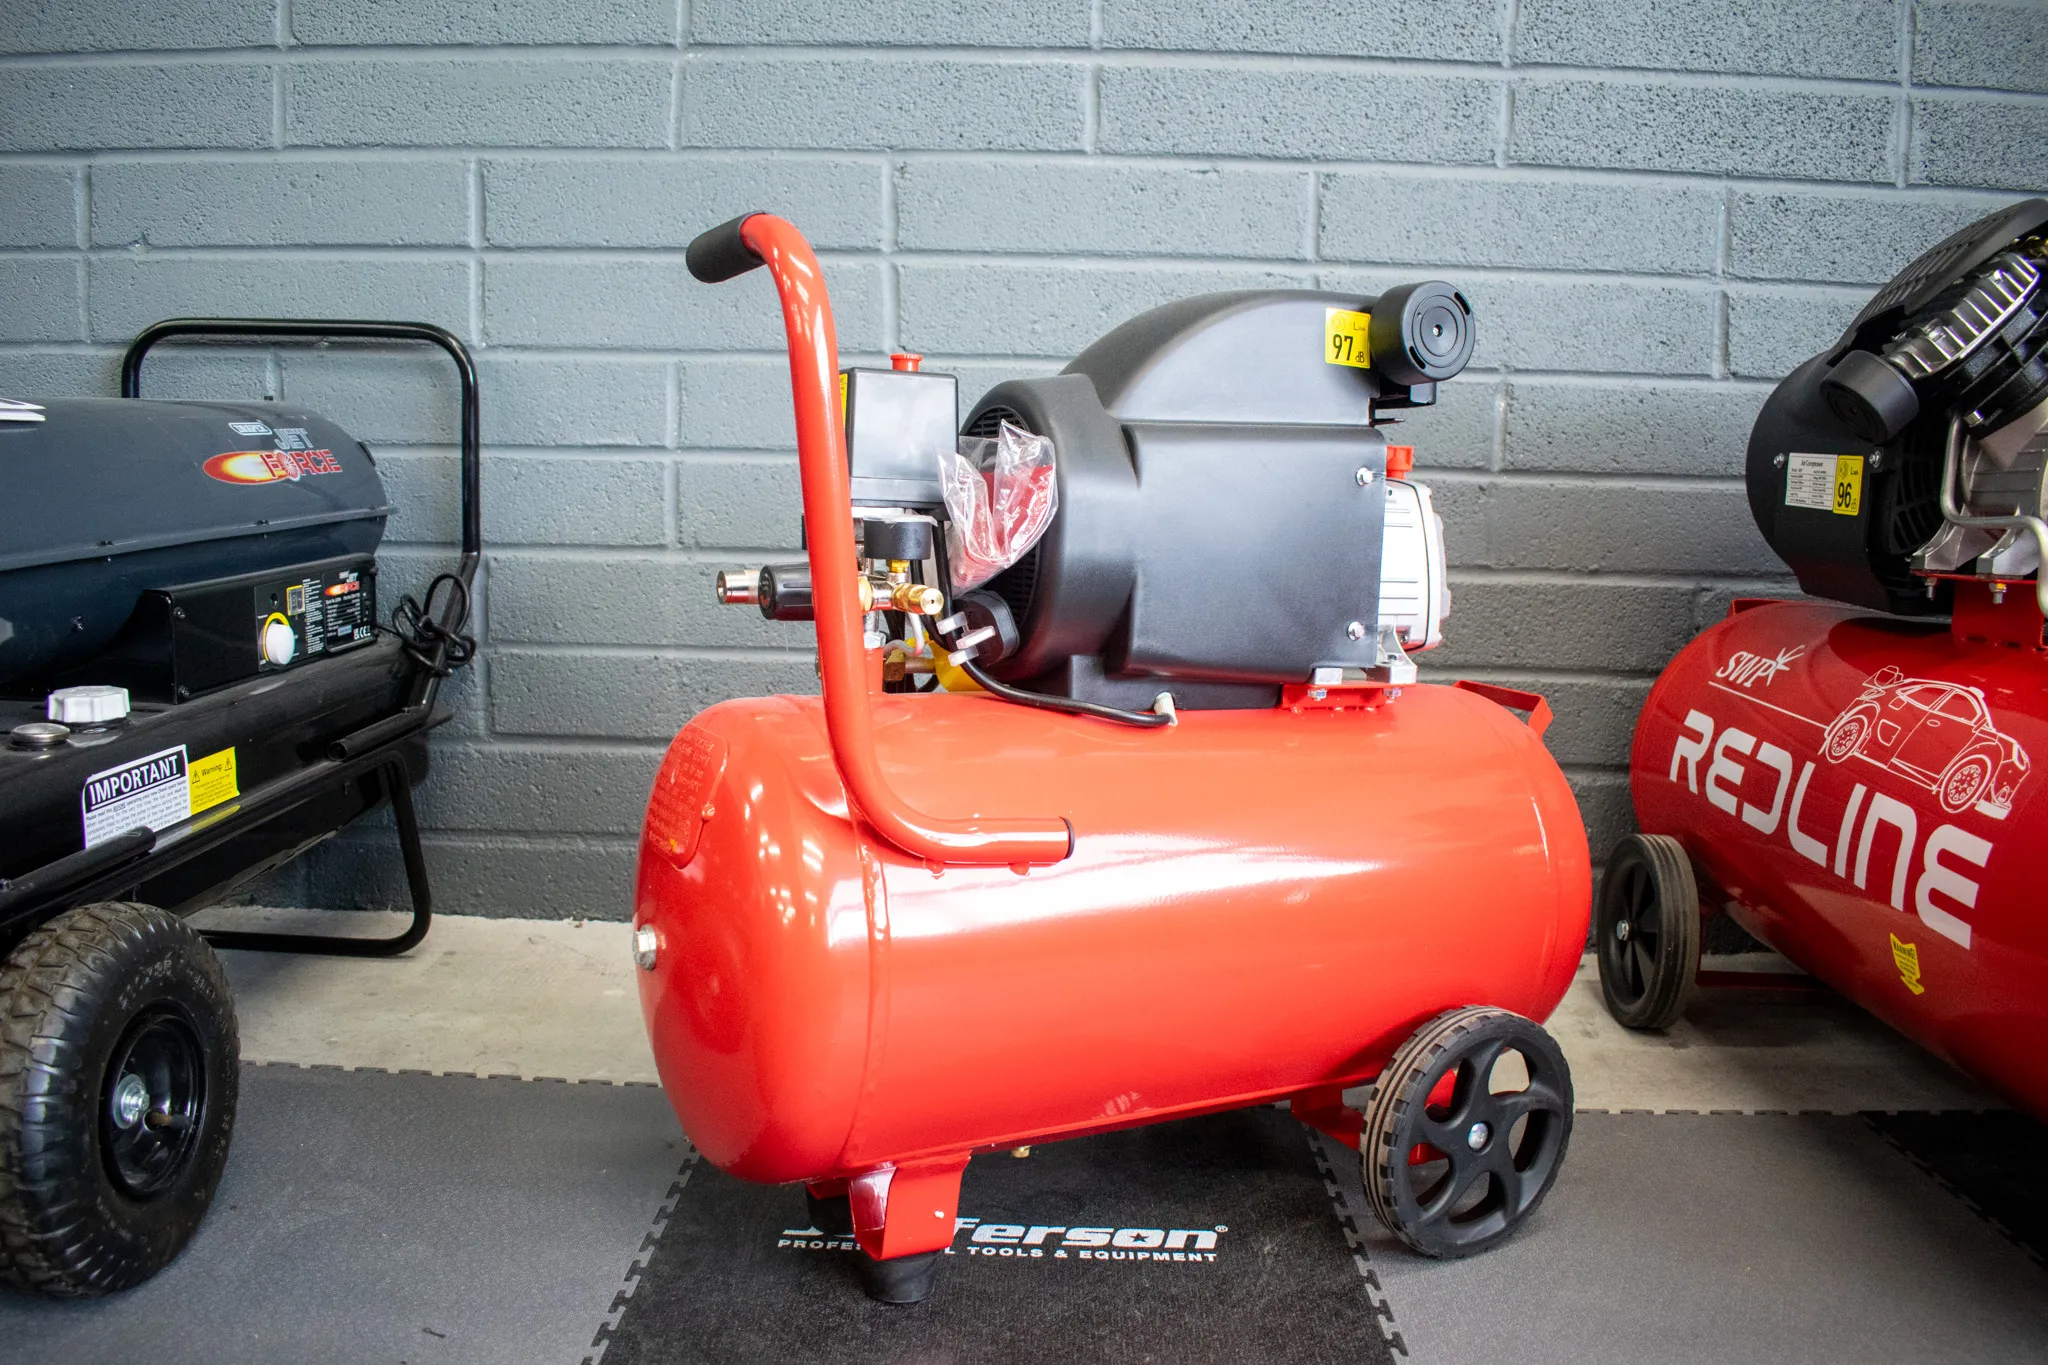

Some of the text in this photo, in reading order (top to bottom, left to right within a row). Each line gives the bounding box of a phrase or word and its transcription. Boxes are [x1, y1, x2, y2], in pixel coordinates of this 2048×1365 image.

[1332, 333, 1365, 363] 97 dB
[273, 427, 313, 449] JET
[259, 449, 343, 482] FORCE
[1837, 481, 1852, 509] 96
[89, 754, 178, 805] IMPORTANT
[1669, 709, 1994, 950] REDLINE
[967, 1246, 1044, 1258] TOOLS
[1054, 1249, 1068, 1259] &
[1079, 1250, 1217, 1262] EQUIPMENT
